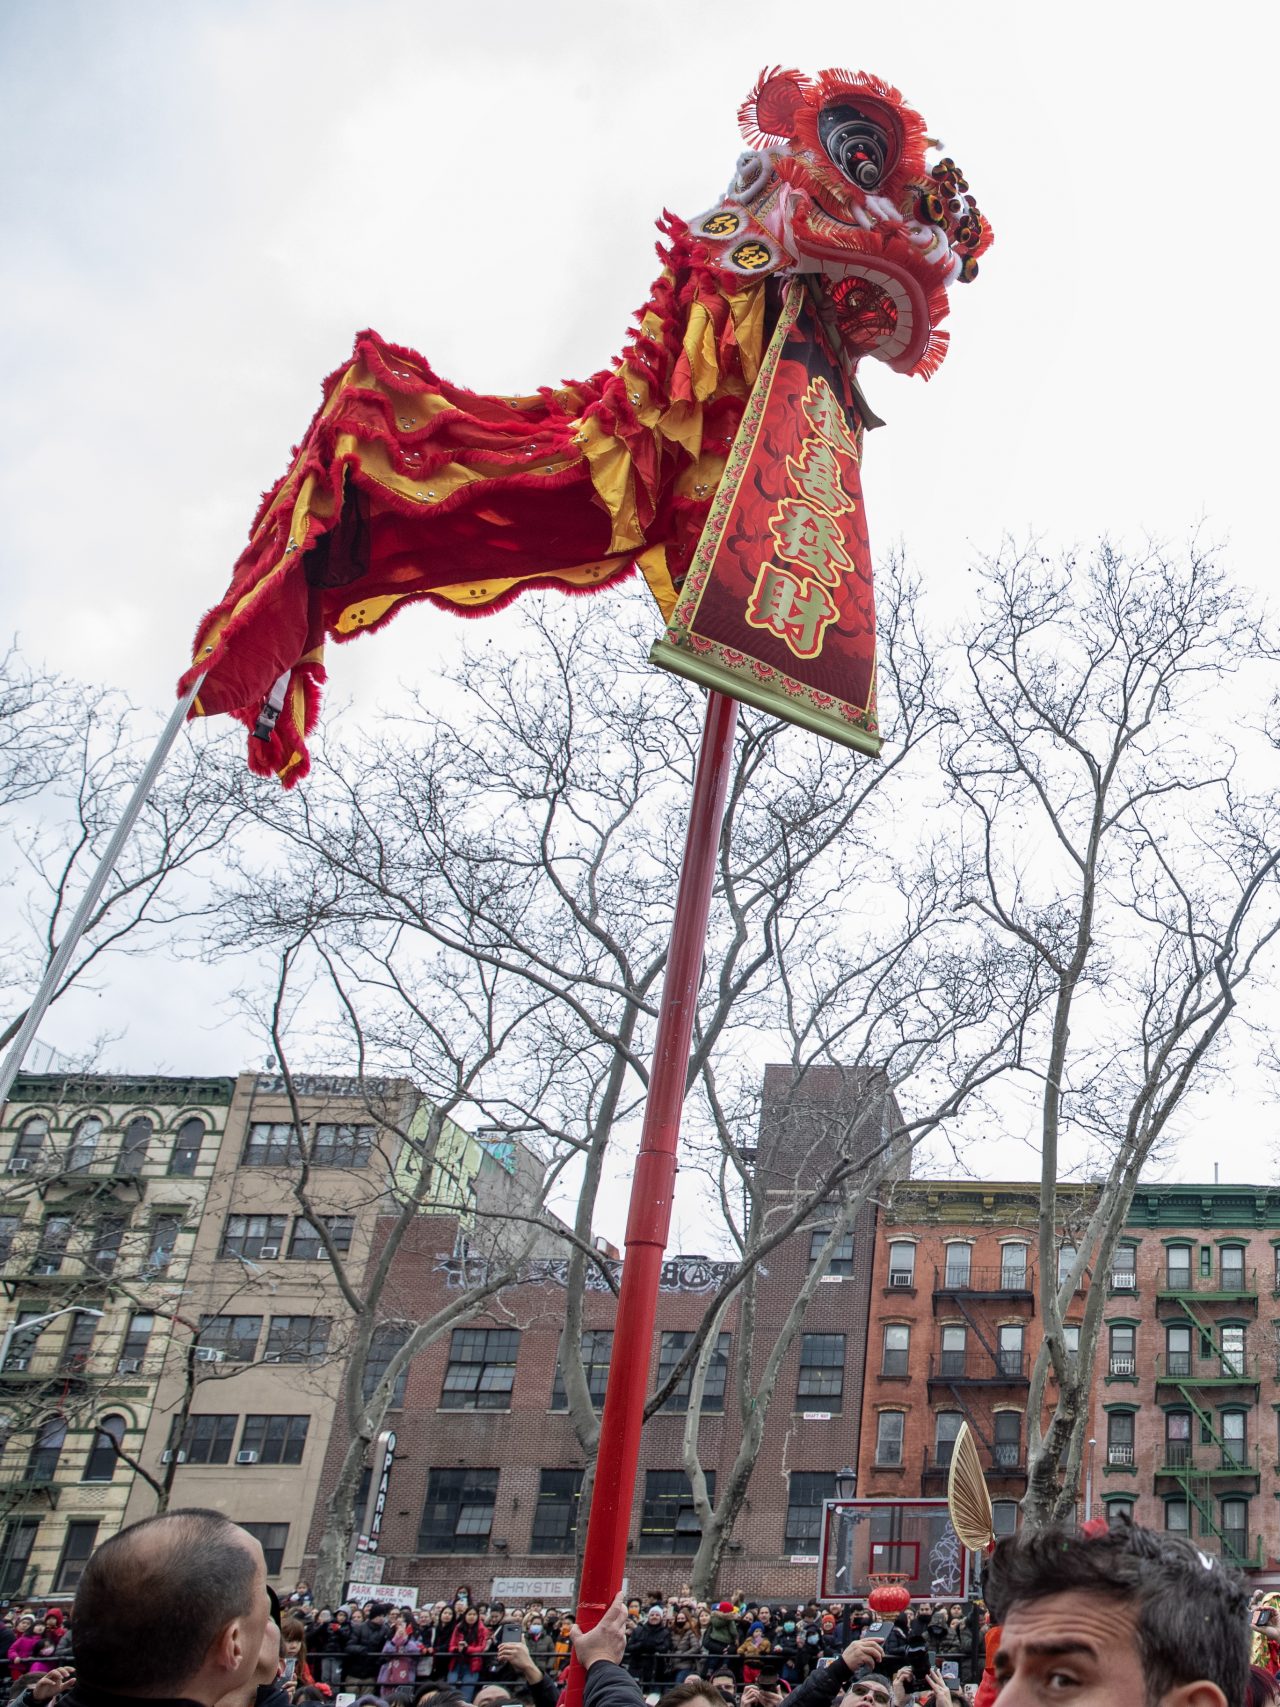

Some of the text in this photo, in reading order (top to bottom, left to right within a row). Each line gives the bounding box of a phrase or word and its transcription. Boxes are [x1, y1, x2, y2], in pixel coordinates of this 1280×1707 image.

[372, 1452, 393, 1533] PARK
[351, 1585, 371, 1595] PARK
[375, 1587, 395, 1597] HERE
[496, 1581, 563, 1594] CHRYSTIE
